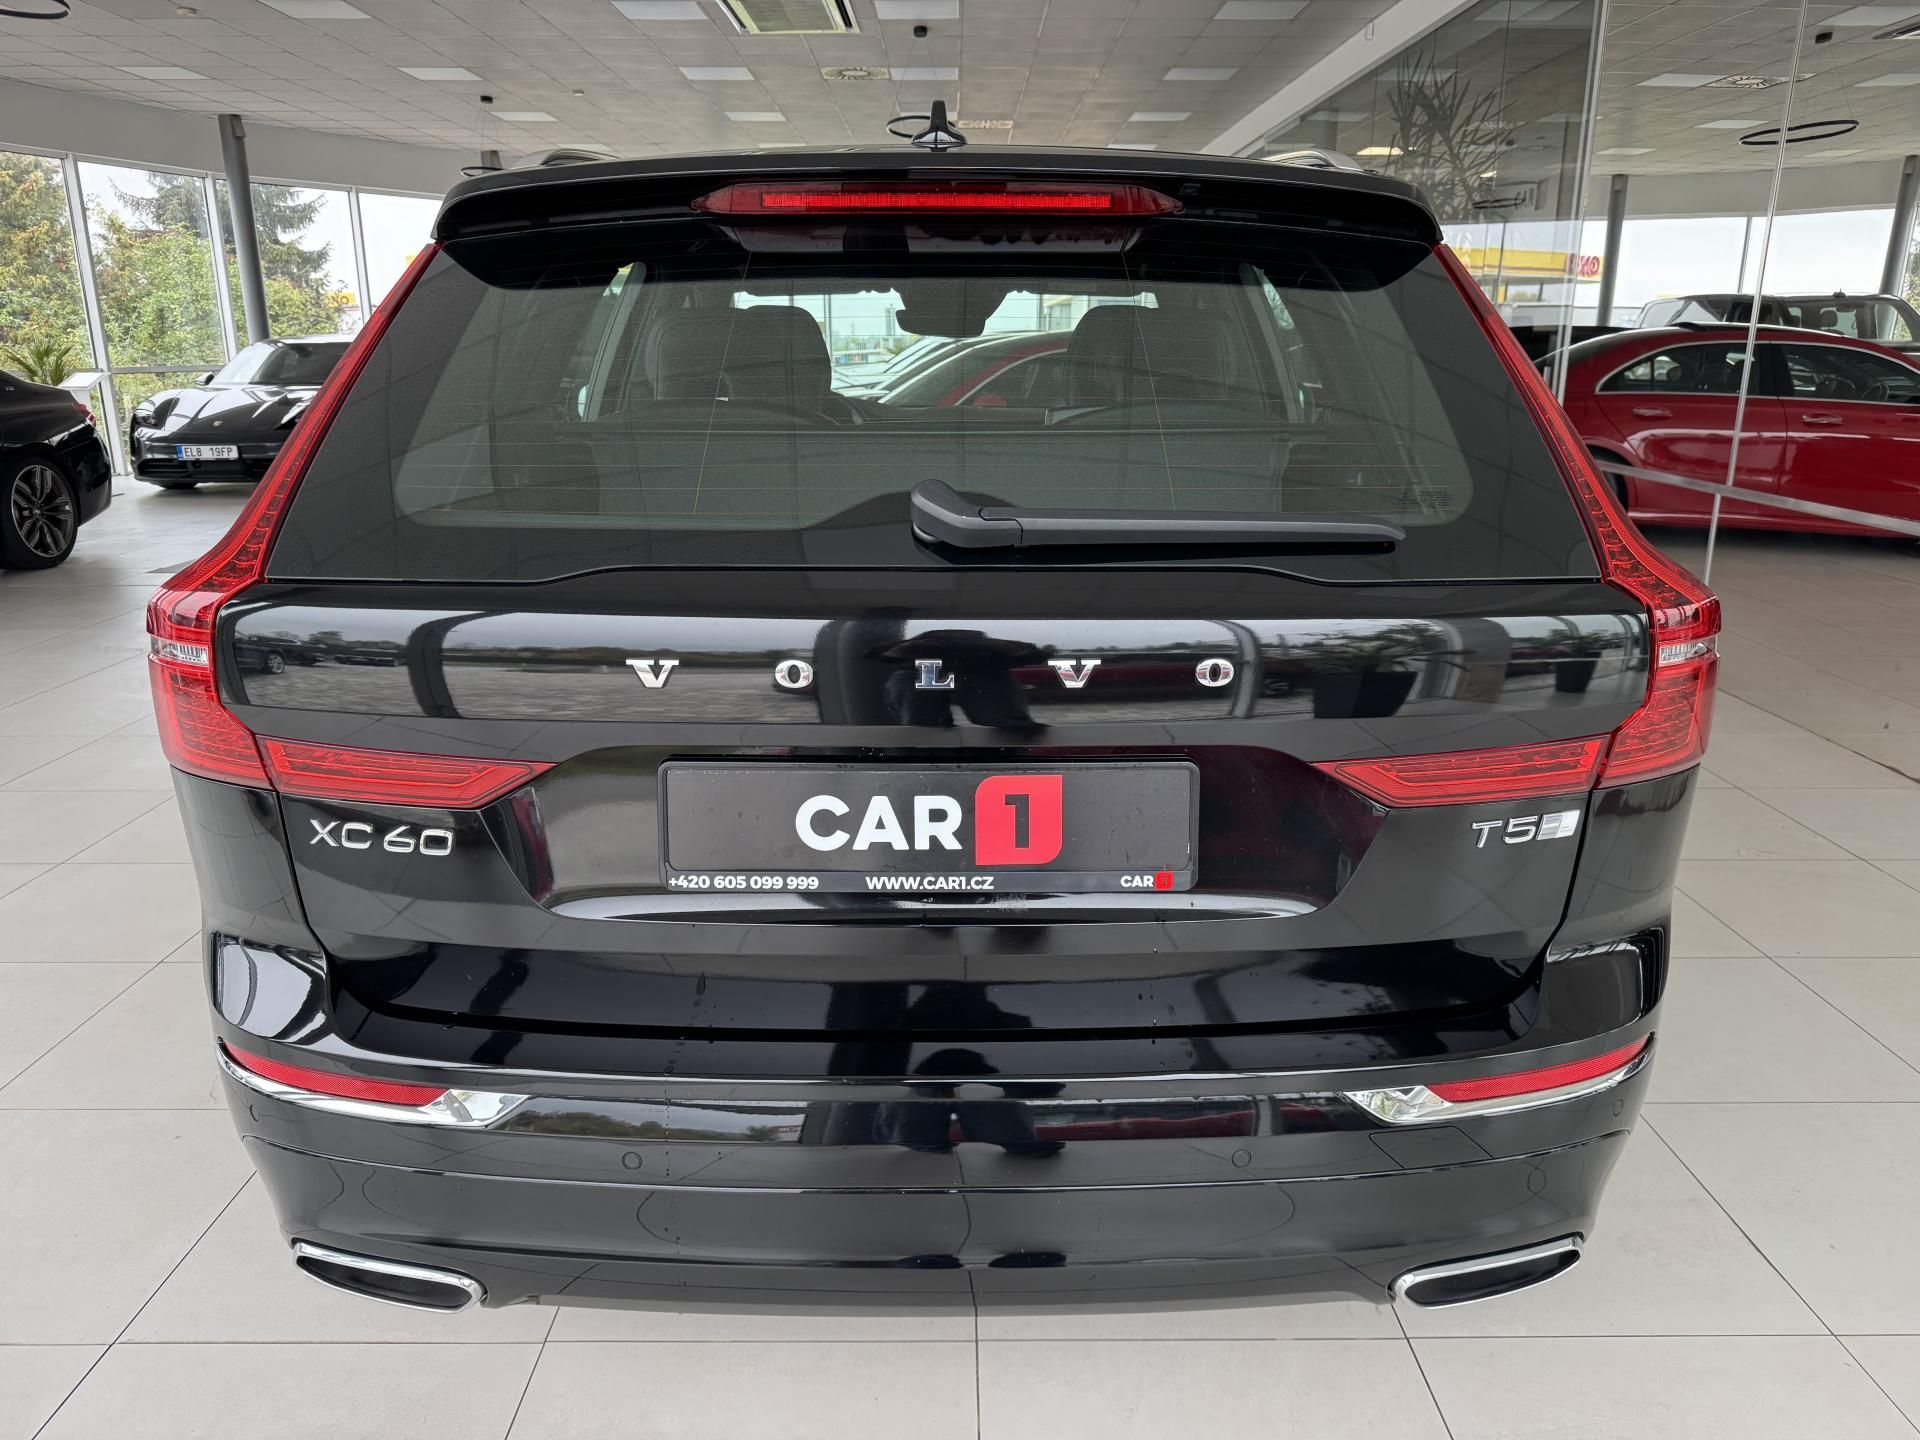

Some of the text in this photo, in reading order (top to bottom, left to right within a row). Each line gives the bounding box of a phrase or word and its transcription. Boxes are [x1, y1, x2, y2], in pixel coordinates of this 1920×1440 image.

[184, 447, 202, 457] EL8
[1471, 815, 1539, 849] T5
[668, 875, 819, 890] +420 605 099 999
[865, 876, 995, 890] WWW.CAR1.CZ
